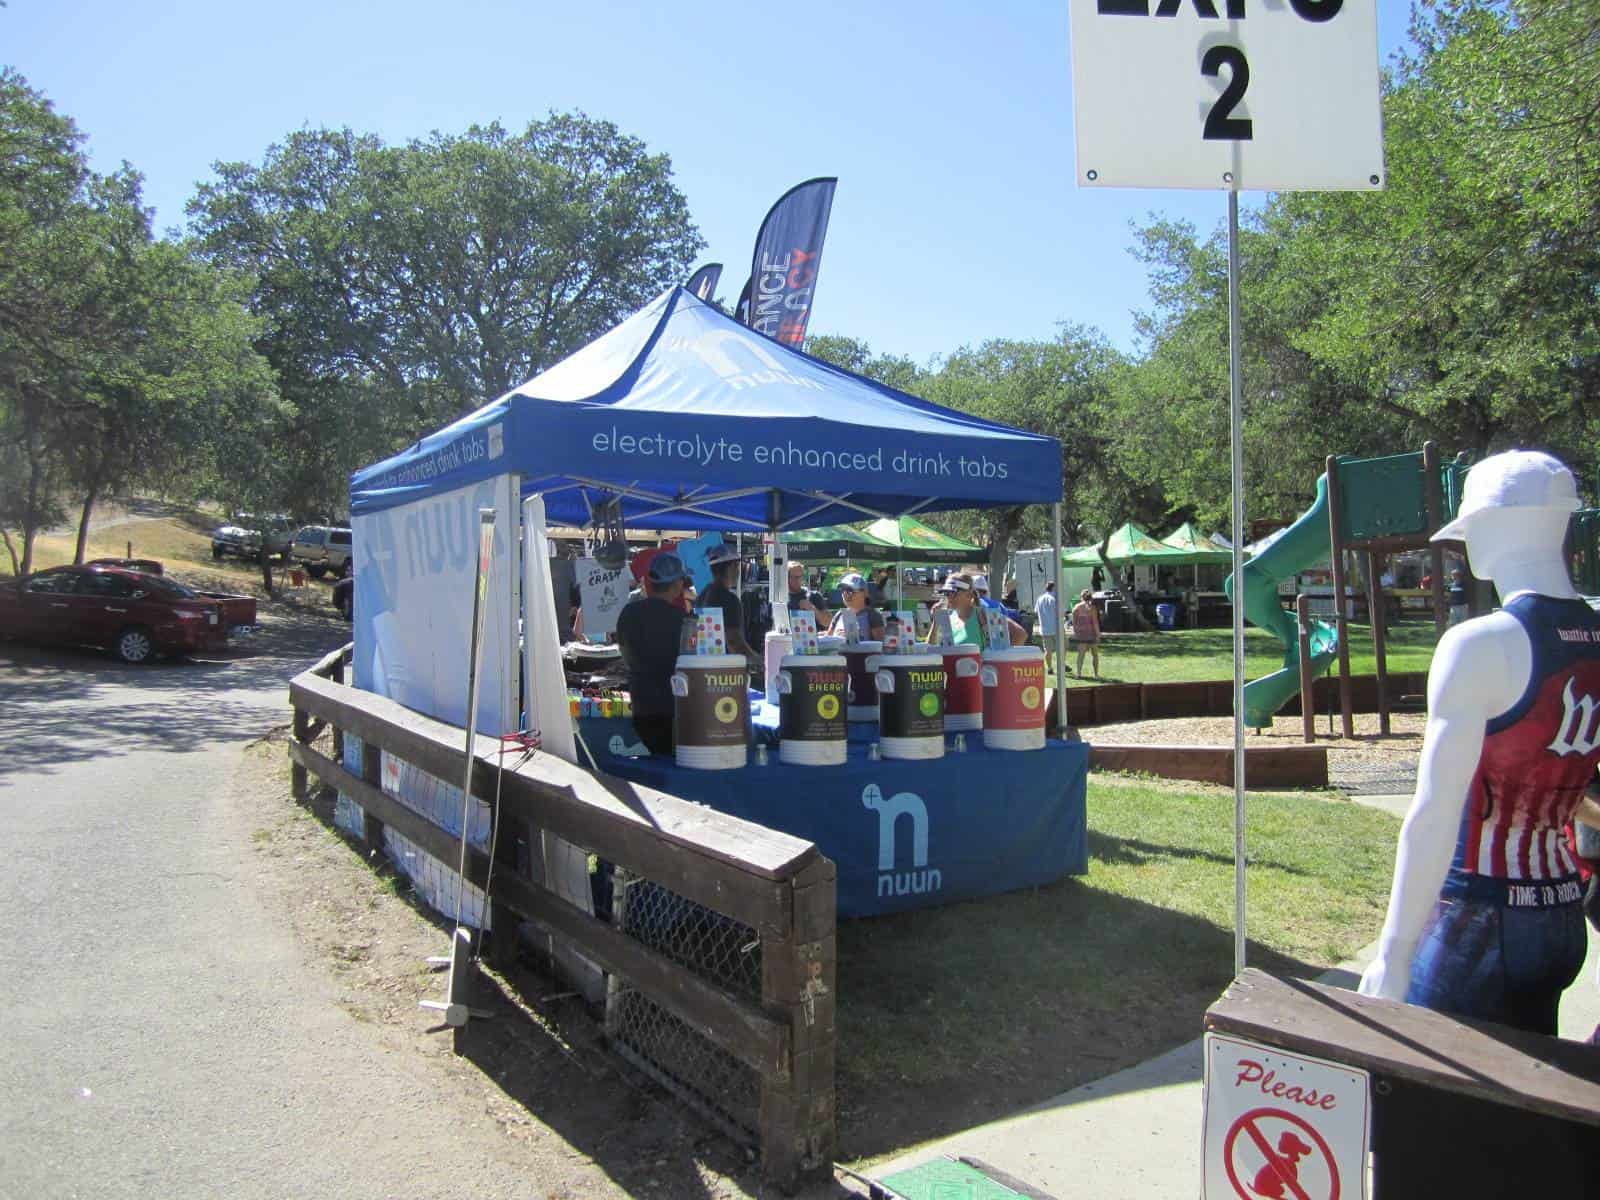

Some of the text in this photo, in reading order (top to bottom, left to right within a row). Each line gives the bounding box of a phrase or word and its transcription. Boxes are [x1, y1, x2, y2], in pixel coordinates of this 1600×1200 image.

[1201, 46, 1252, 140] 2
[462, 435, 485, 464] tabs
[592, 424, 1009, 480] electrolyte enhanced drink tabs
[704, 673, 744, 687] nuun
[908, 671, 943, 683] nuun
[877, 869, 941, 896] nuun
[1508, 881, 1582, 907] TIME TO ROCK
[1235, 1059, 1337, 1110] Please
